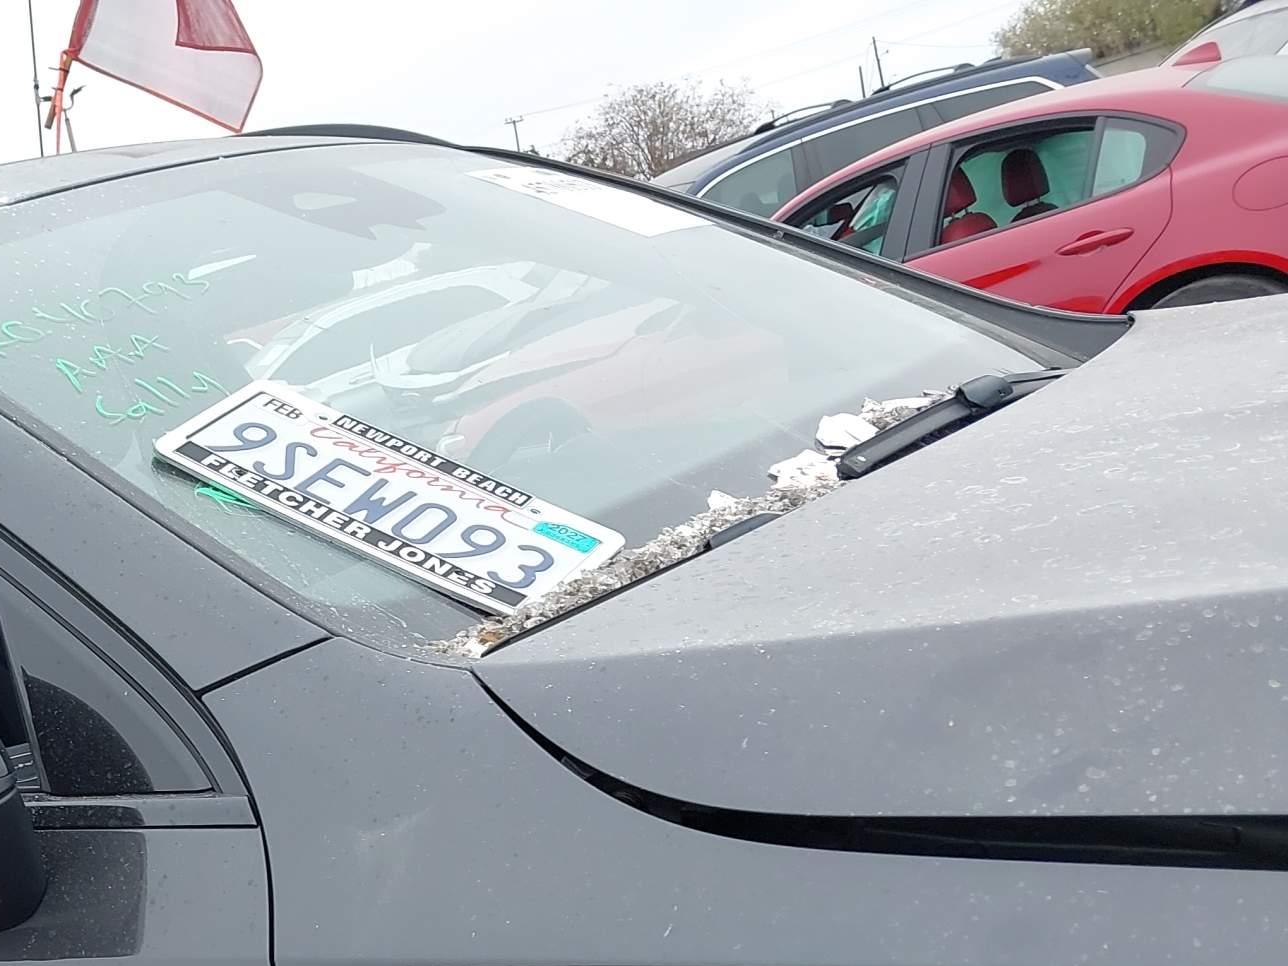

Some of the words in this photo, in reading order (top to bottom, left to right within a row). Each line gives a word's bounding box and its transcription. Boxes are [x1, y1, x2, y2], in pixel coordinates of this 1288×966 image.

[263, 398, 304, 419] FEB
[205, 422, 554, 589] 9SEW093
[310, 424, 528, 526] California
[339, 417, 444, 466] NEWPORT
[454, 465, 530, 505] BEACH
[201, 455, 370, 540] FLETCHER
[376, 538, 494, 594] JONES
[548, 523, 588, 542] 2027
